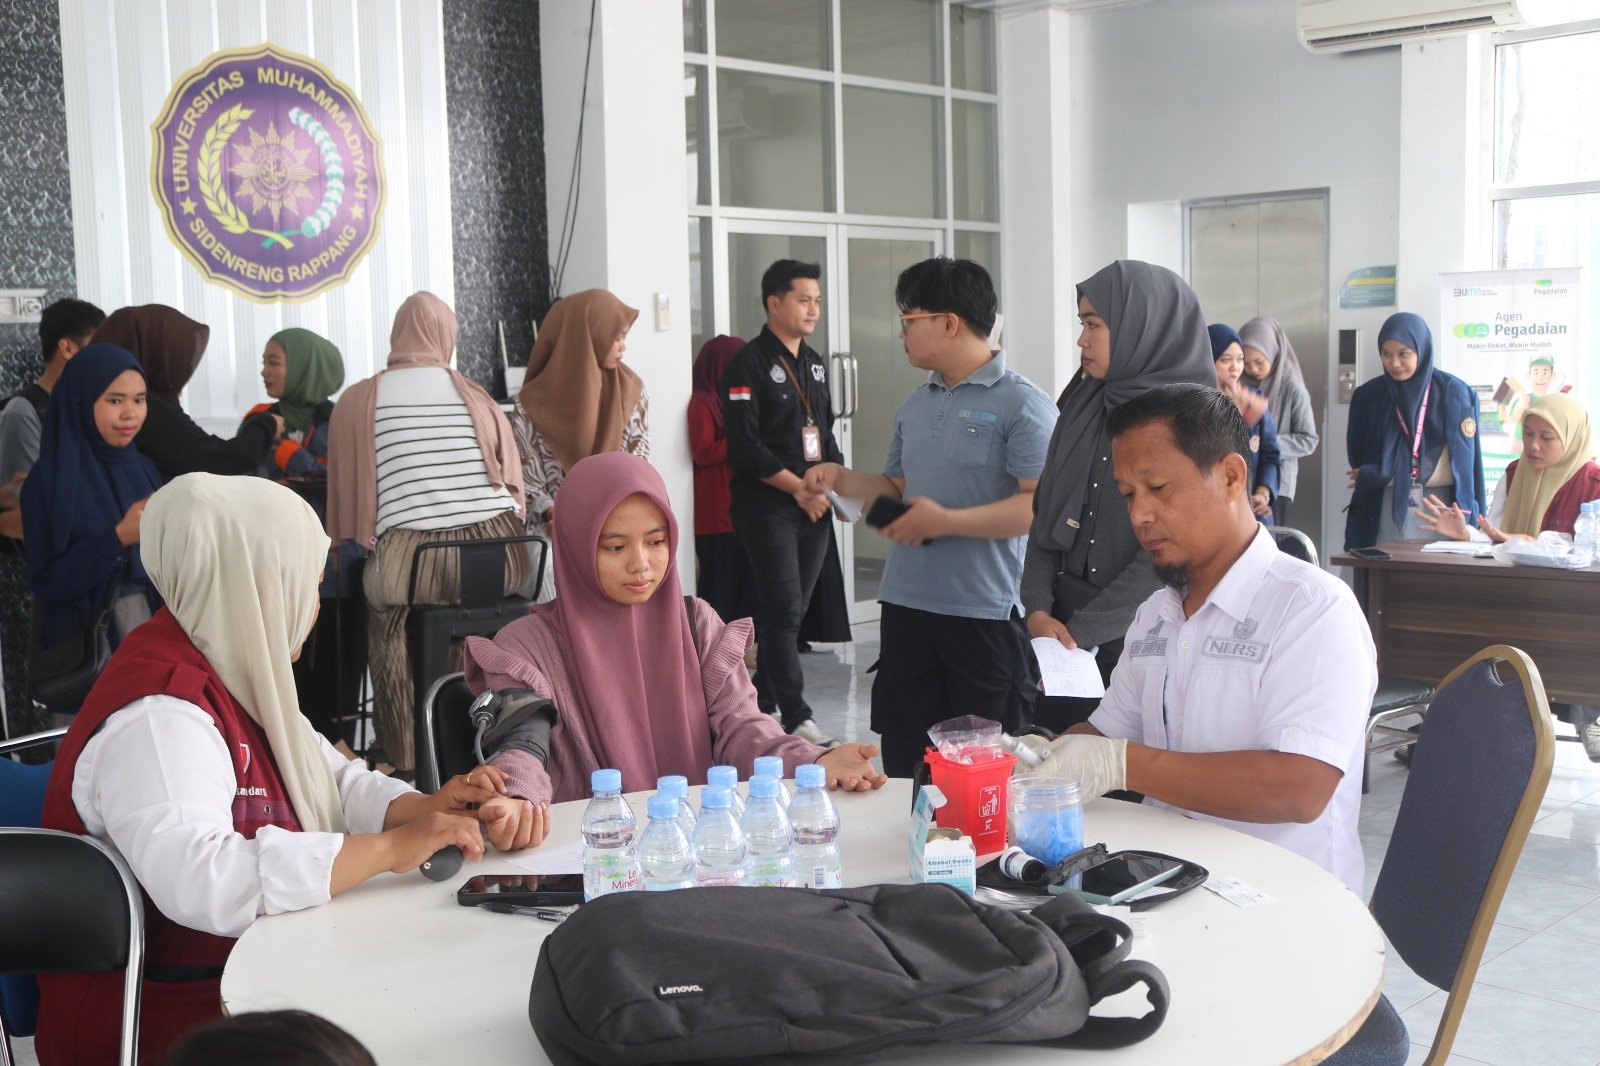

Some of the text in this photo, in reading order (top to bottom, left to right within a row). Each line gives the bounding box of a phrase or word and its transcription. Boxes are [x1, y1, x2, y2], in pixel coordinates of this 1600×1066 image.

[172, 67, 368, 200] UNIVERSITAS MUHAMMADIYAH
[189, 217, 357, 284] SIDENRENG RAPPANG
[1533, 287, 1568, 296] Pegadaian
[1495, 312, 1523, 324] Agen
[1494, 322, 1567, 339] Pegadaian
[1210, 640, 1257, 658] NERS
[659, 984, 701, 996] Lenovo
